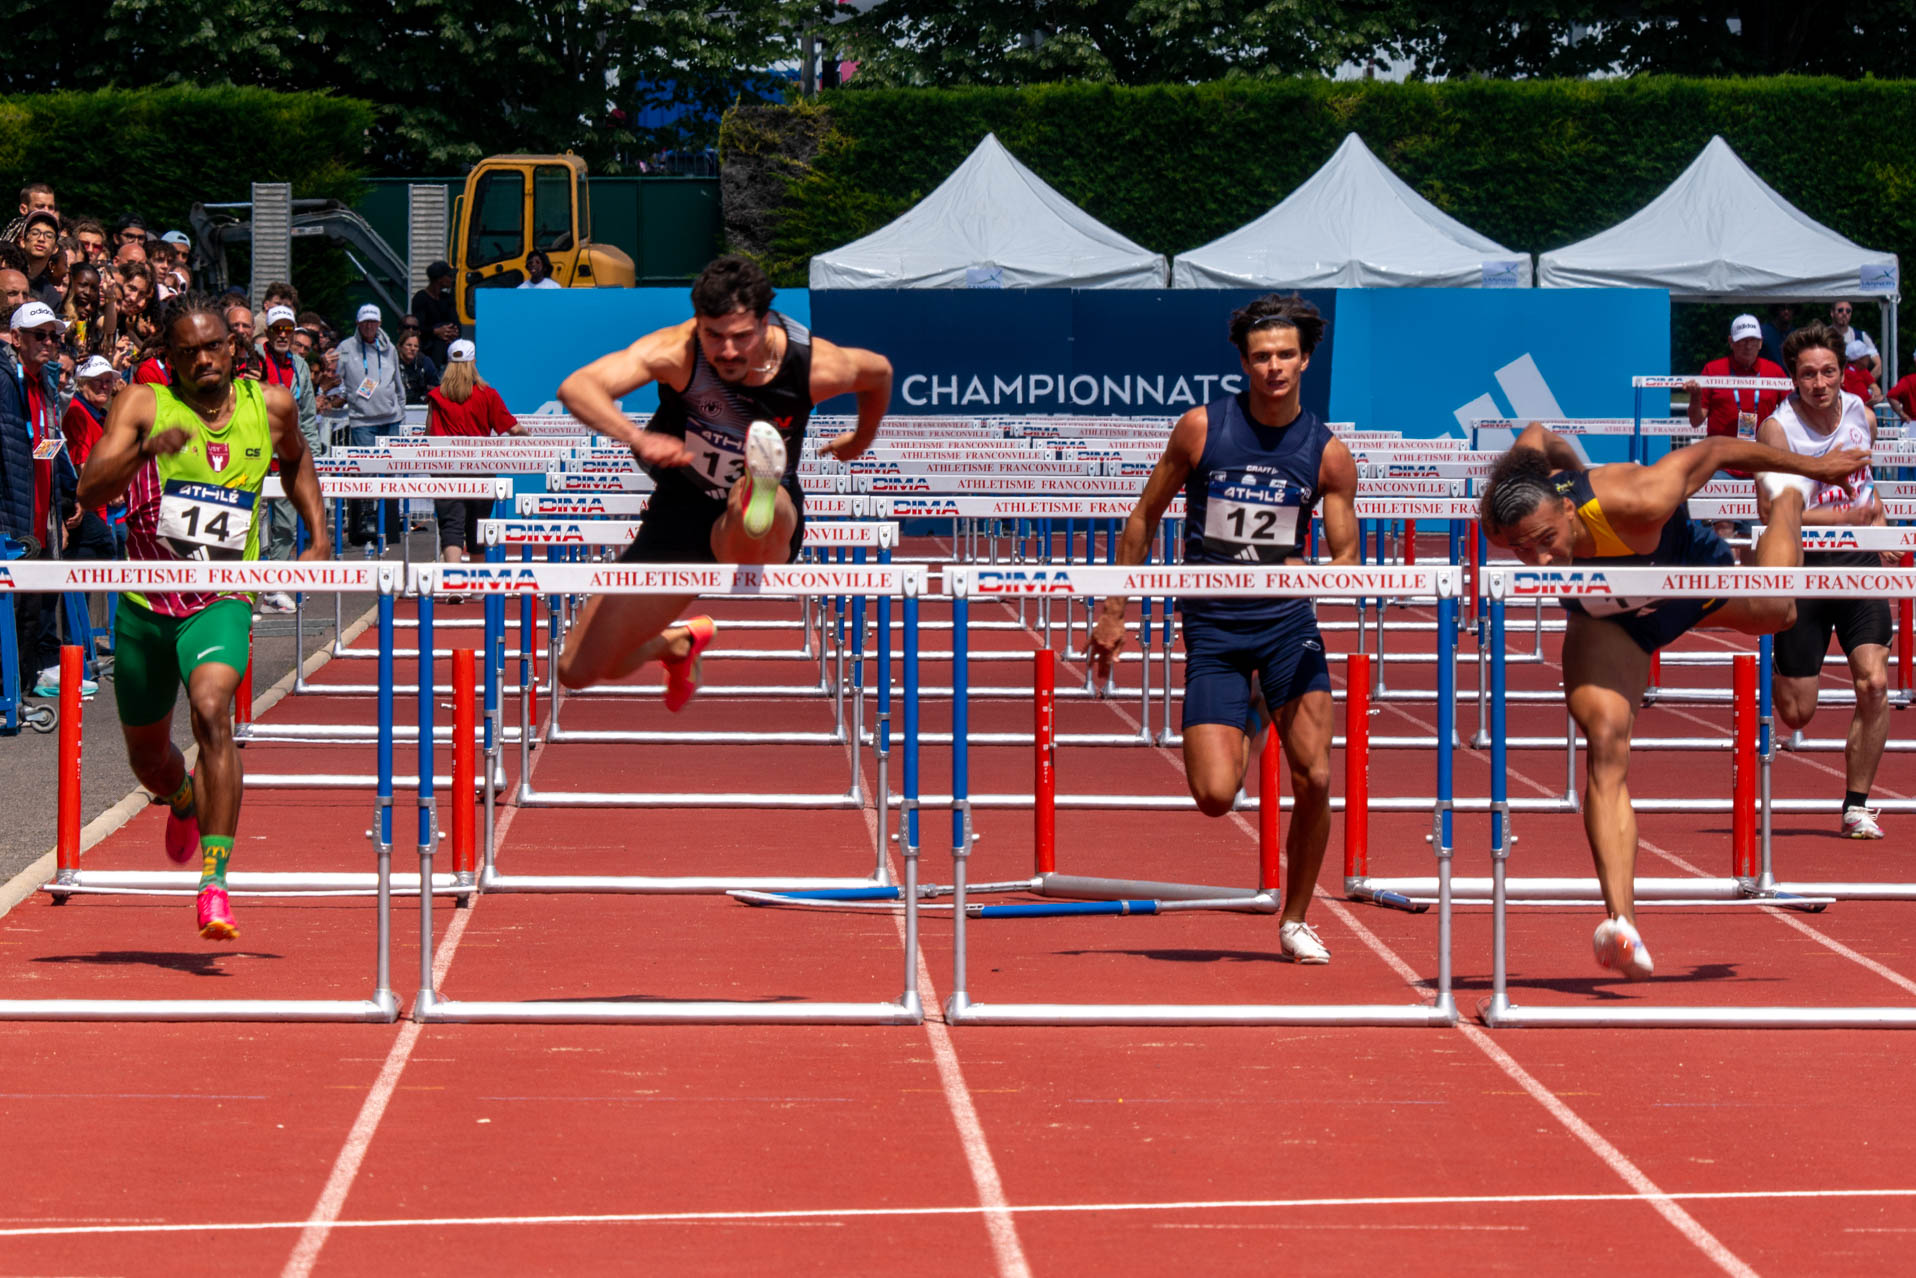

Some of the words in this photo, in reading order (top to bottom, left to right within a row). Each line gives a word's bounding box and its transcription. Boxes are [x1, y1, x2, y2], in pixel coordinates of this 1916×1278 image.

[901, 374, 1242, 405] CHAMPIONNATS
[527, 426, 583, 434] RANCONVILLE
[1023, 427, 1060, 437] DIMA
[389, 438, 430, 447] DIMA
[450, 439, 505, 447] ATHLETISME
[509, 439, 577, 447] FRANCONVILLE
[347, 449, 392, 458] DIMA
[415, 449, 477, 458] ATHLETISME
[480, 449, 556, 458] FRANCONVILLE
[900, 451, 961, 459] ATHLETISME
[965, 452, 1041, 460] FRANCONVILLE
[1077, 451, 1123, 461] DIMA
[1392, 453, 1454, 461] ATHLETISME
[386, 461, 454, 471] ATHLETISME
[459, 461, 544, 471] FRANCONVILLE
[582, 461, 634, 473] DIMA
[849, 462, 901, 474] DIMA
[926, 463, 995, 472] ATHLETISME
[999, 464, 1082, 473] FRANCONVILLE
[1389, 464, 1440, 477] DIMA
[320, 481, 374, 493] ETISME
[379, 481, 490, 494] FRANCONVILLE
[565, 475, 624, 489] DIMA
[872, 477, 930, 490] DIMA
[957, 479, 1036, 490] ATHLETISME
[1041, 480, 1137, 491] FRANCONVILLE
[1357, 482, 1446, 493] RANCONVILLE
[179, 484, 240, 504] ATHLÉ
[1224, 486, 1286, 503] ATHLÉ
[538, 497, 606, 513] DIMA
[893, 500, 960, 515] DIMA
[993, 502, 1083, 514] ATHLETISME
[1354, 502, 1444, 514] ATHLETISME
[181, 505, 230, 543] 14
[1226, 507, 1278, 540] 12
[505, 524, 585, 542] DIMA
[1801, 530, 1859, 548] IMA
[66, 568, 197, 585] ATHLETISME
[208, 568, 369, 585] FRANCONVILLE
[442, 568, 540, 591] DIMA
[590, 571, 720, 588] ATHLETISME
[731, 572, 893, 588] FRANCONVILLE
[978, 571, 1075, 593] DIMA
[1123, 572, 1256, 589] ATHLETISME
[1266, 573, 1427, 590] FRANCONVILLE
[1513, 572, 1612, 594] DIMA
[1661, 573, 1795, 590] ATHLETISME
[1805, 574, 1916, 591] FRANCONV
